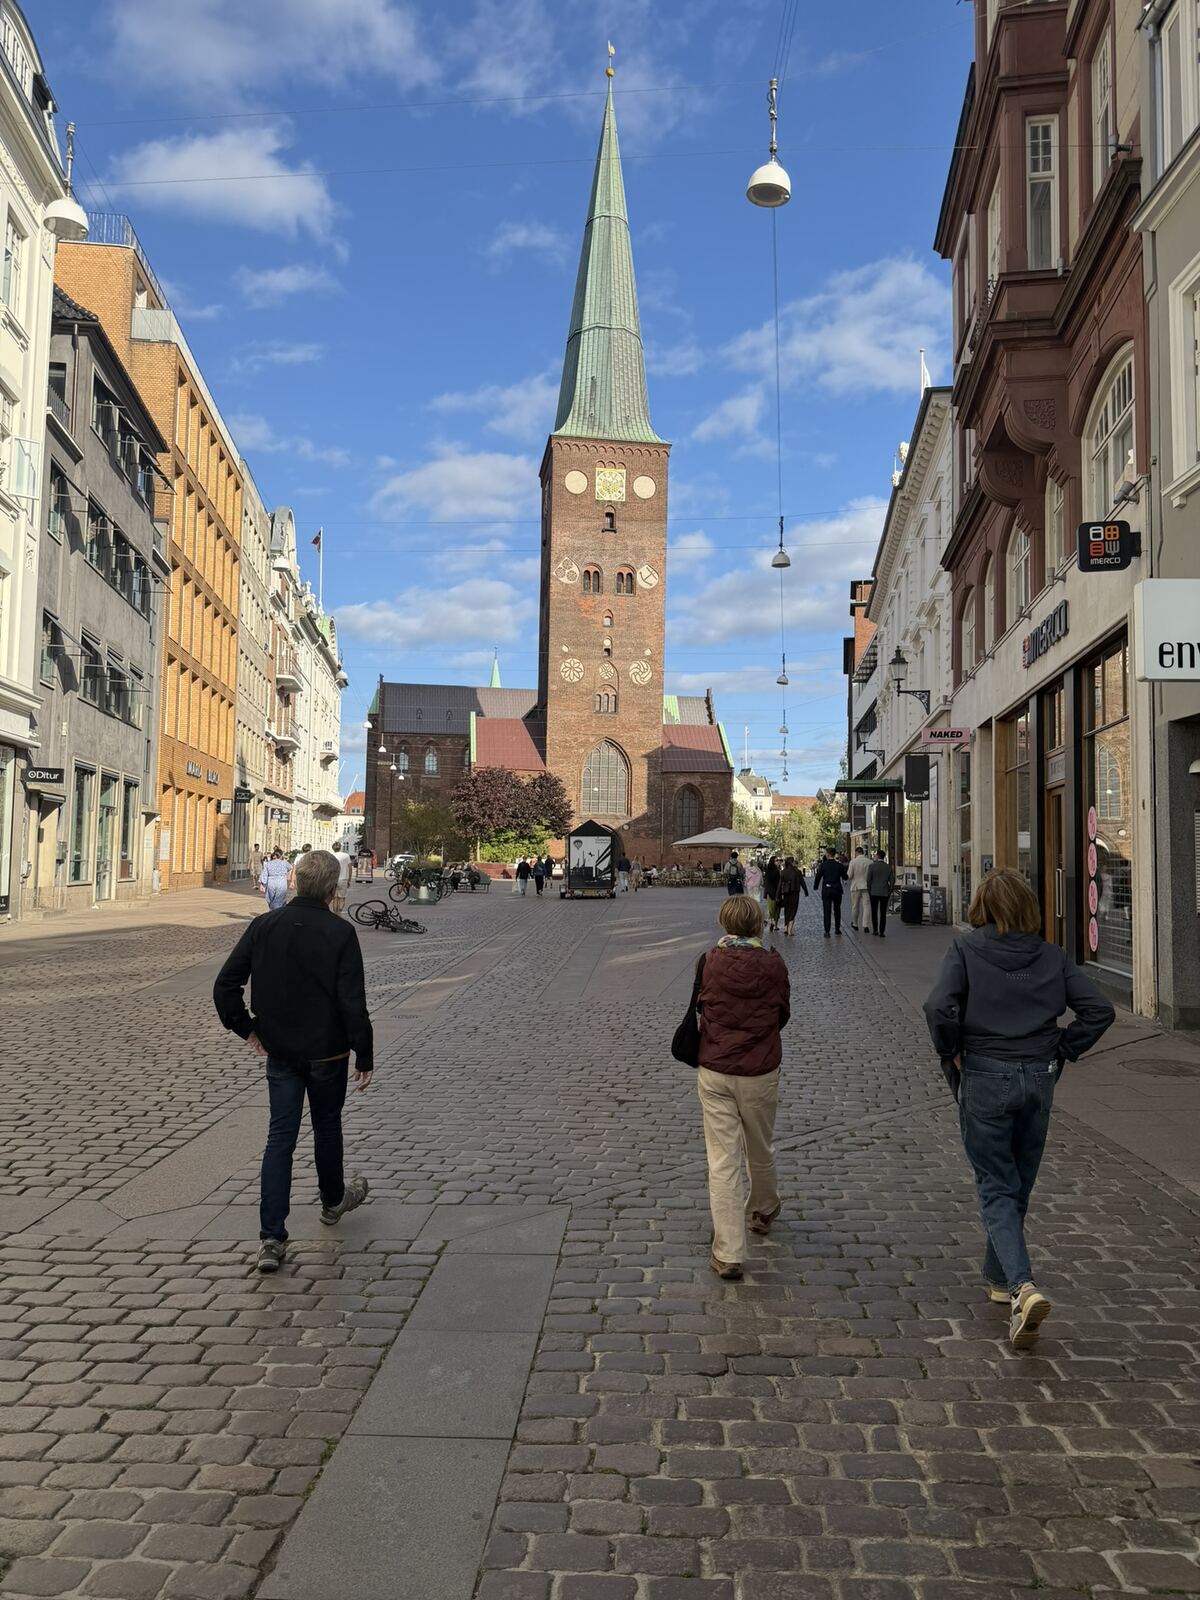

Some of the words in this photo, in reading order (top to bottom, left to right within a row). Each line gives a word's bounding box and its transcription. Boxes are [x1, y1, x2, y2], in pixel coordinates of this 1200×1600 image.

[1091, 557, 1121, 565] IMERCO
[1029, 599, 1068, 663] IMERCO
[1158, 641, 1200, 669] en
[36, 771, 60, 780] Ditur
